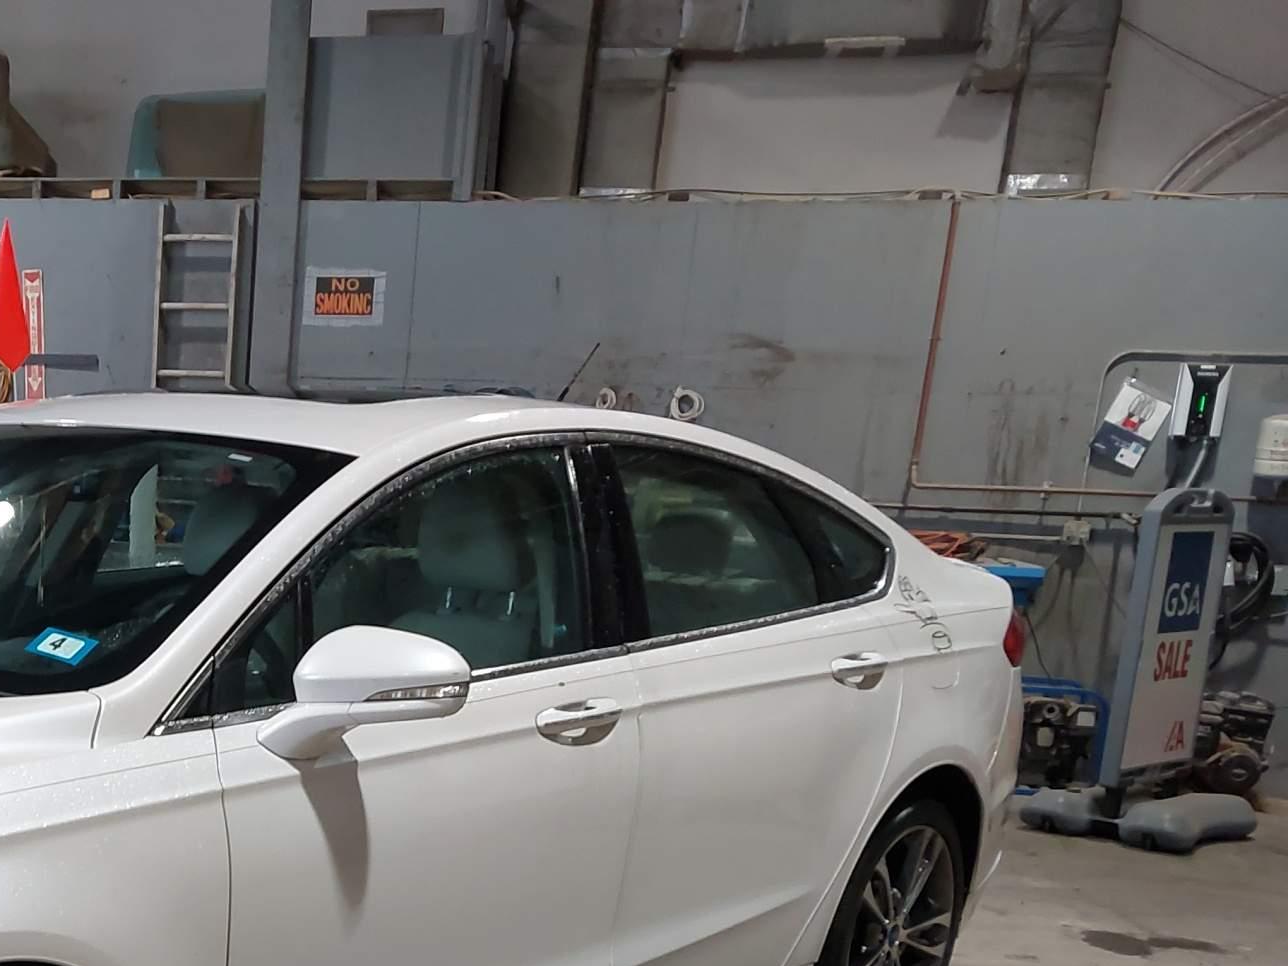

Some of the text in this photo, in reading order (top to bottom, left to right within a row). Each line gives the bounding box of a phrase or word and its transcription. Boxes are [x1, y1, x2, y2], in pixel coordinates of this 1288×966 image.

[331, 278, 360, 292] NO
[1164, 582, 1200, 617] GSA
[48, 637, 68, 651] 4
[1153, 639, 1193, 682] SALE
